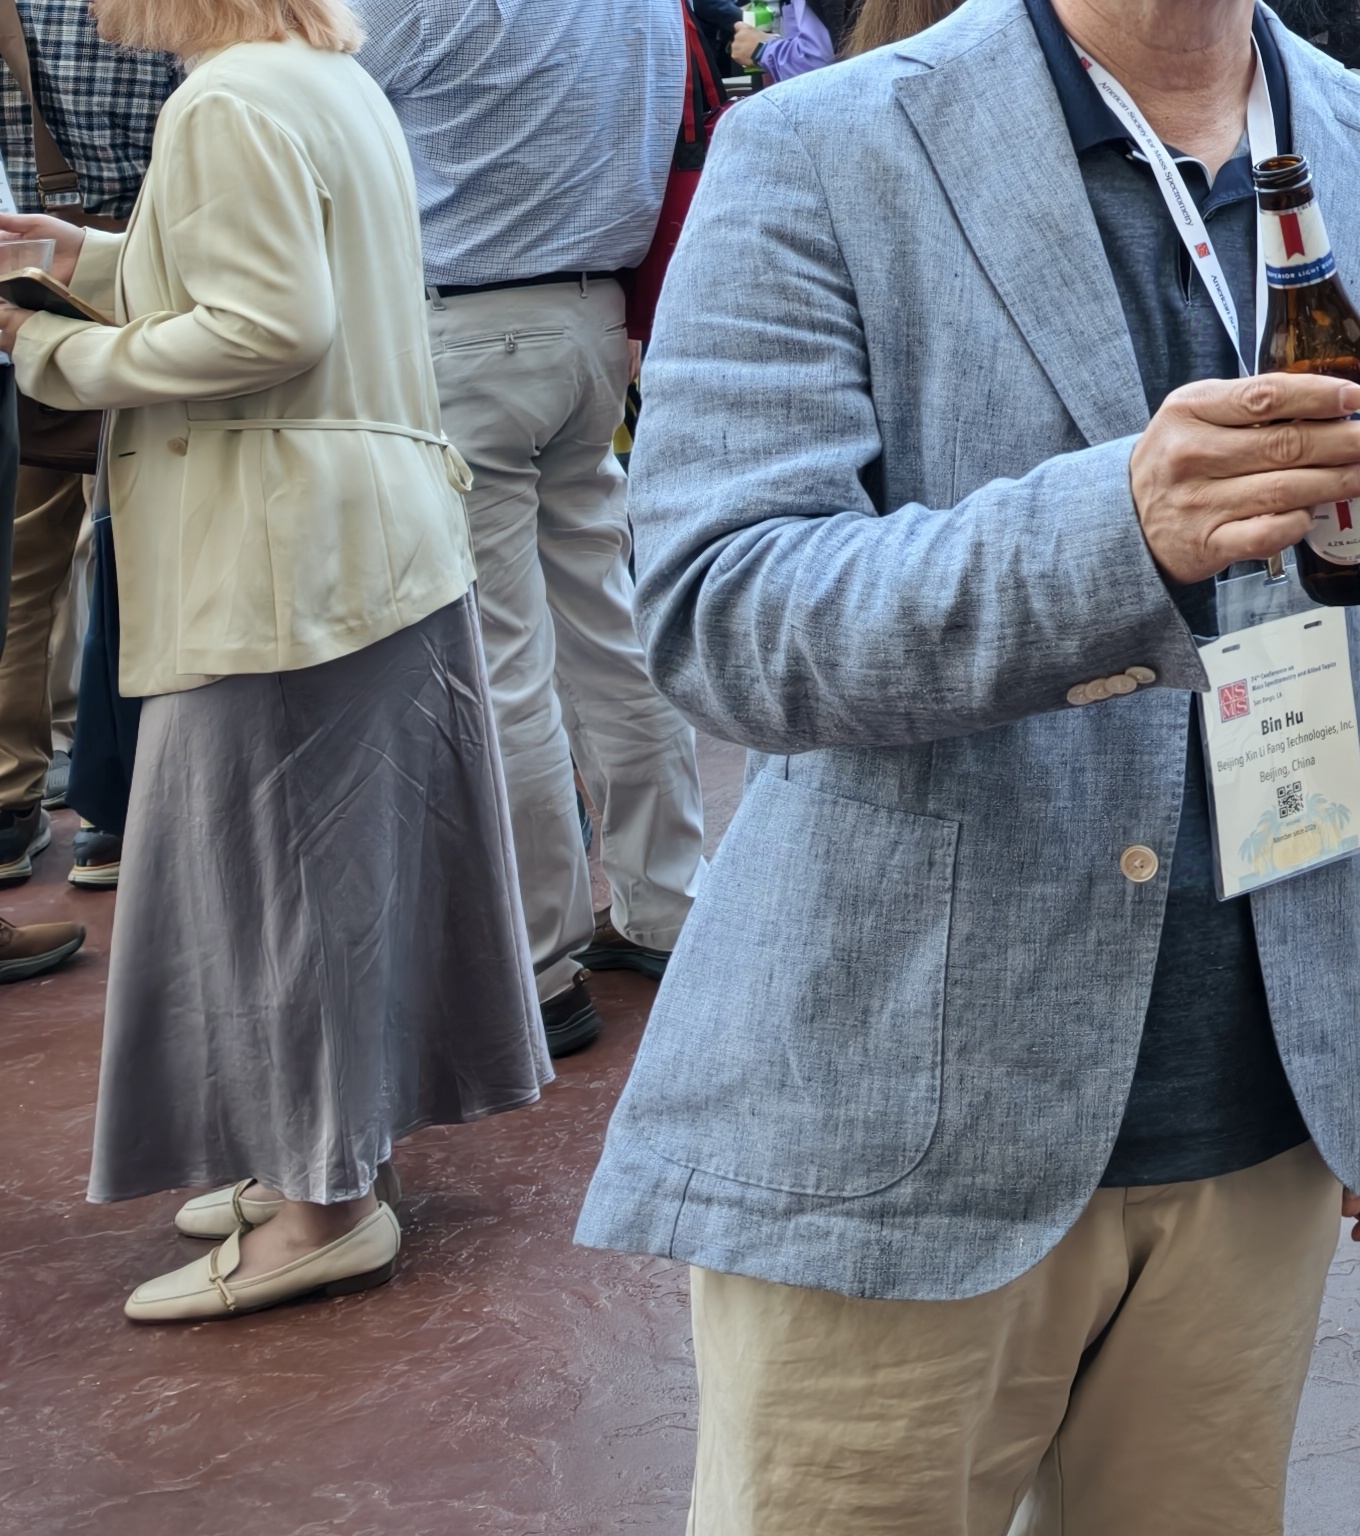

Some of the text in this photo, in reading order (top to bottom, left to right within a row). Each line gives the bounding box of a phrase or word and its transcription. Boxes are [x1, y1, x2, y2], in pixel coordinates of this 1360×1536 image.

[1099, 82, 1193, 226] American Society for Mass Spectrometry
[1298, 266, 1320, 277] LIGHT
[1211, 274, 1230, 315] American
[1261, 710, 1304, 736] Bin Hu
[1217, 720, 1354, 772] Beijing Xin Li Fang Technologies, Inc.
[1260, 756, 1316, 783] Beijing, China
